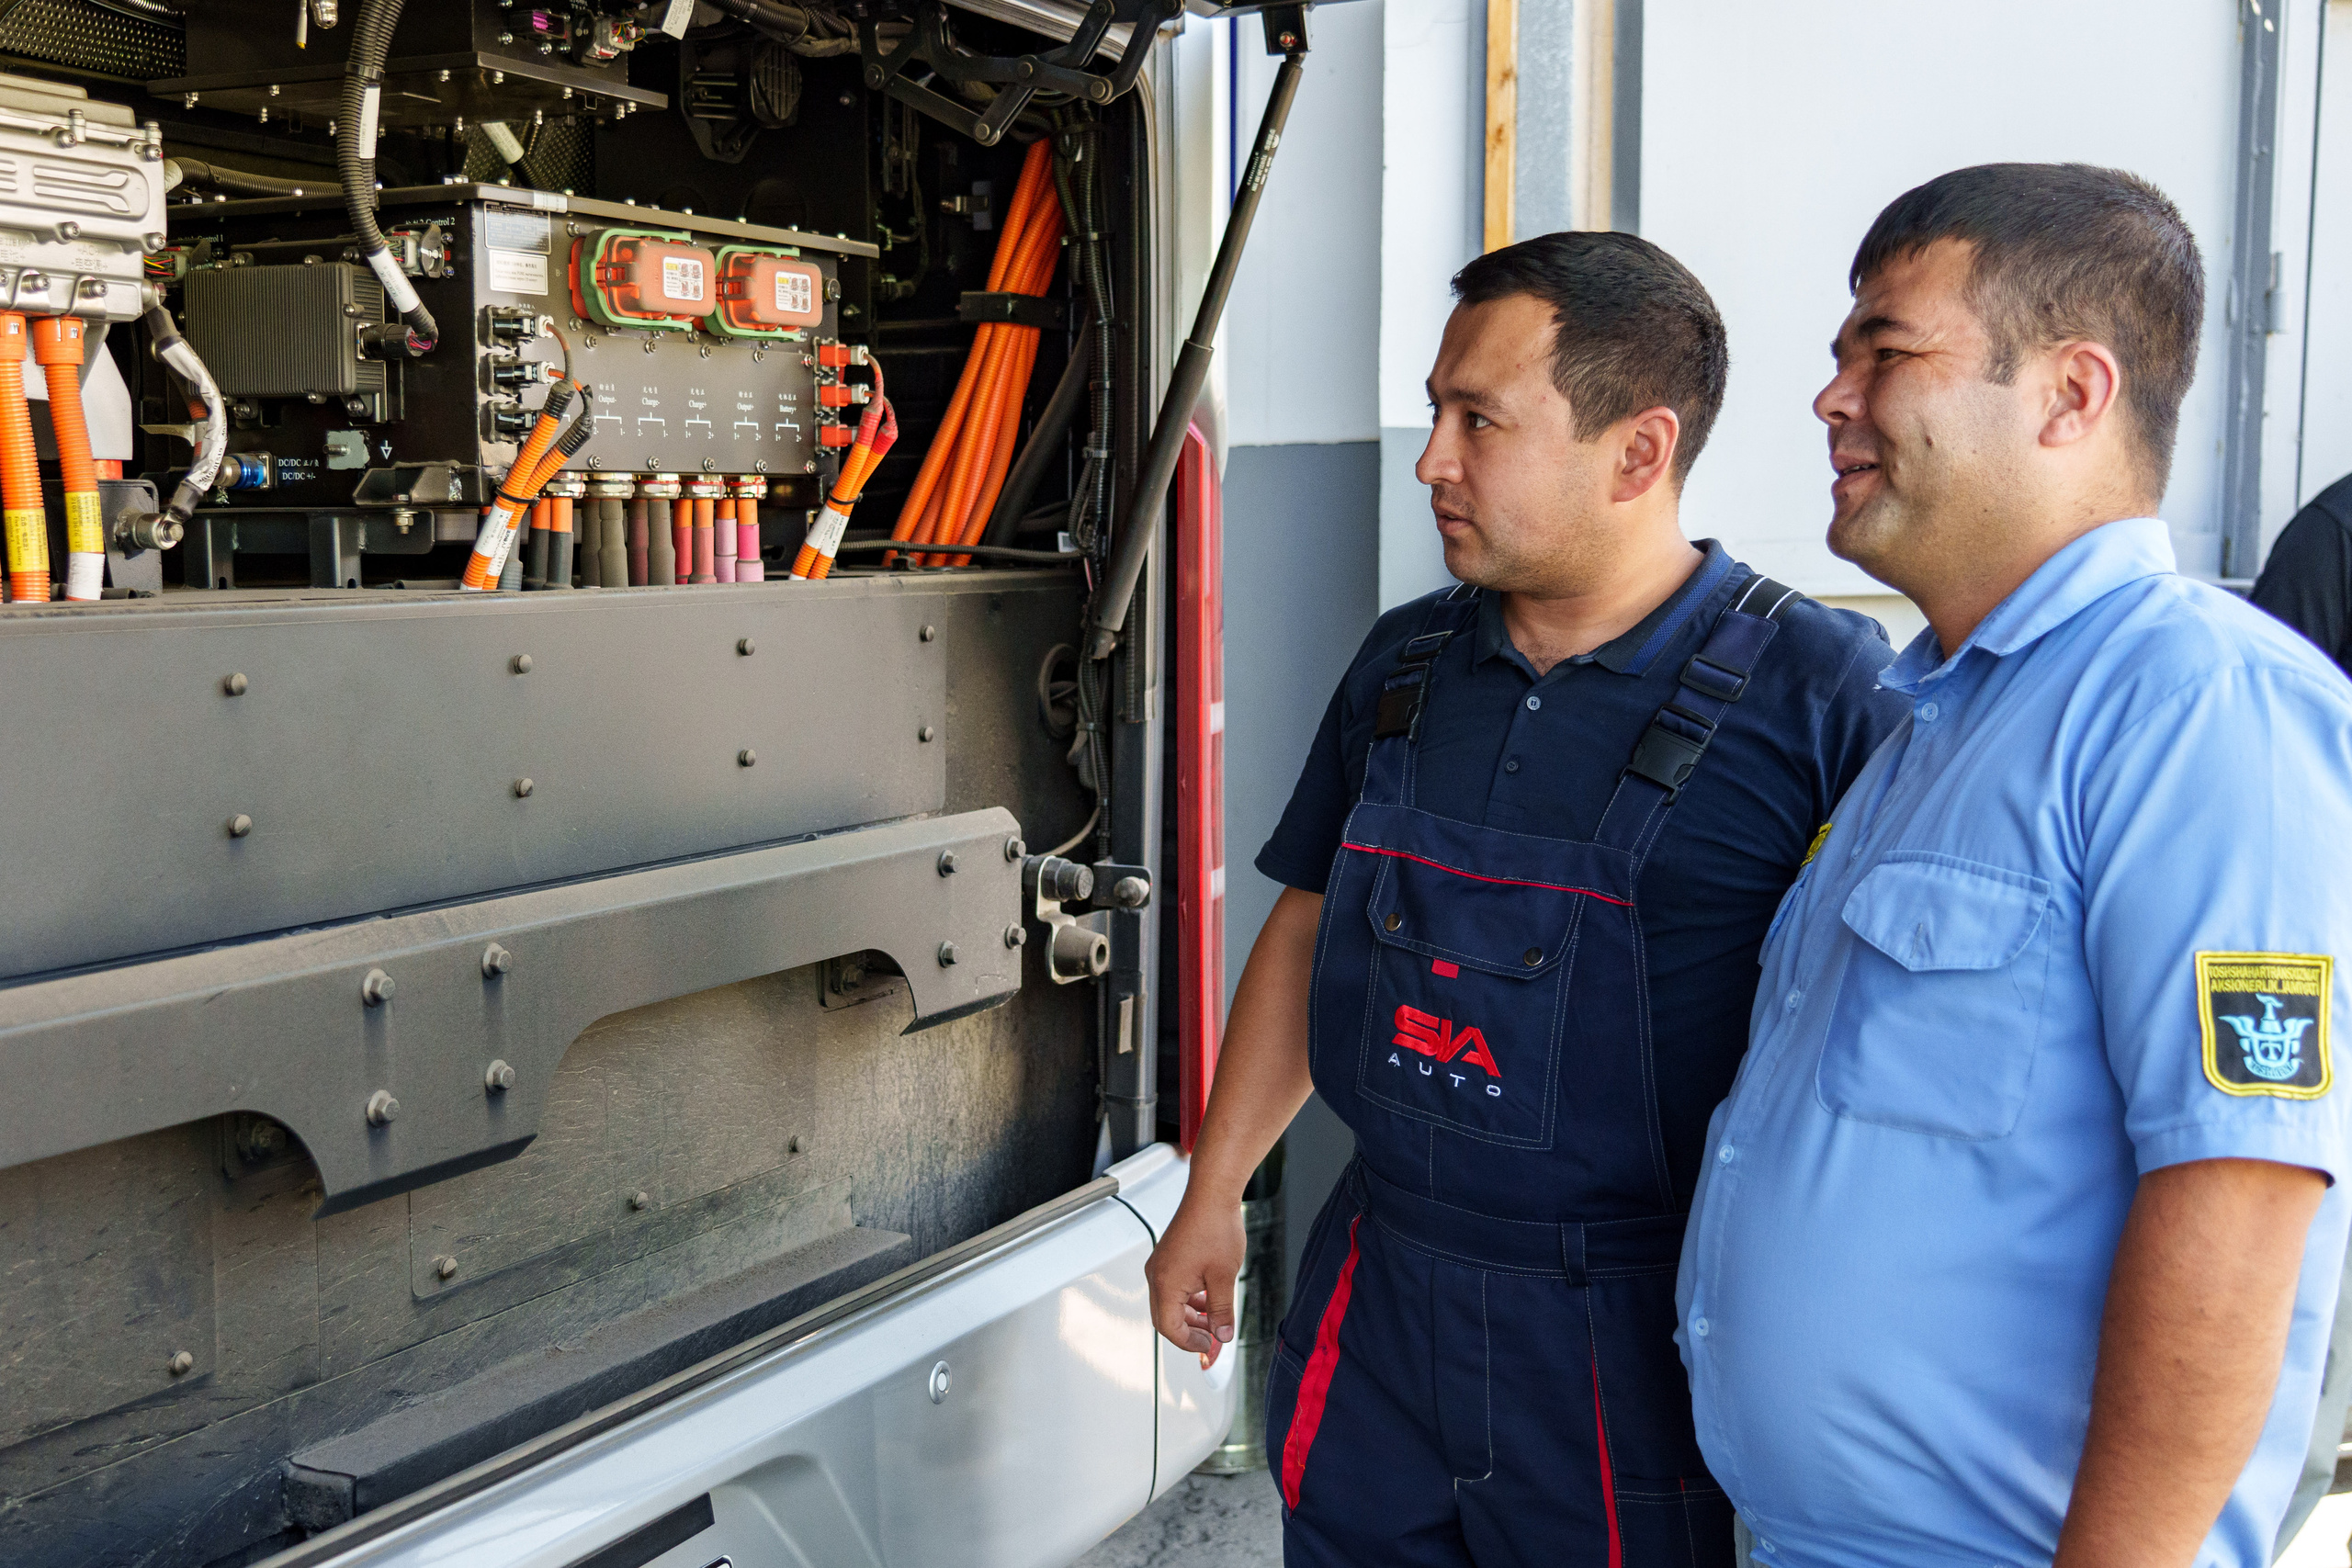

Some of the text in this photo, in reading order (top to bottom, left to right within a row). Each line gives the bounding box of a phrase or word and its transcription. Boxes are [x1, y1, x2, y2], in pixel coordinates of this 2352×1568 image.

[198, 234, 219, 243] Cntrol
[277, 458, 301, 468] DC/DC
[282, 472, 306, 480] DC/DC
[1387, 1052, 1501, 1097] AUTO
